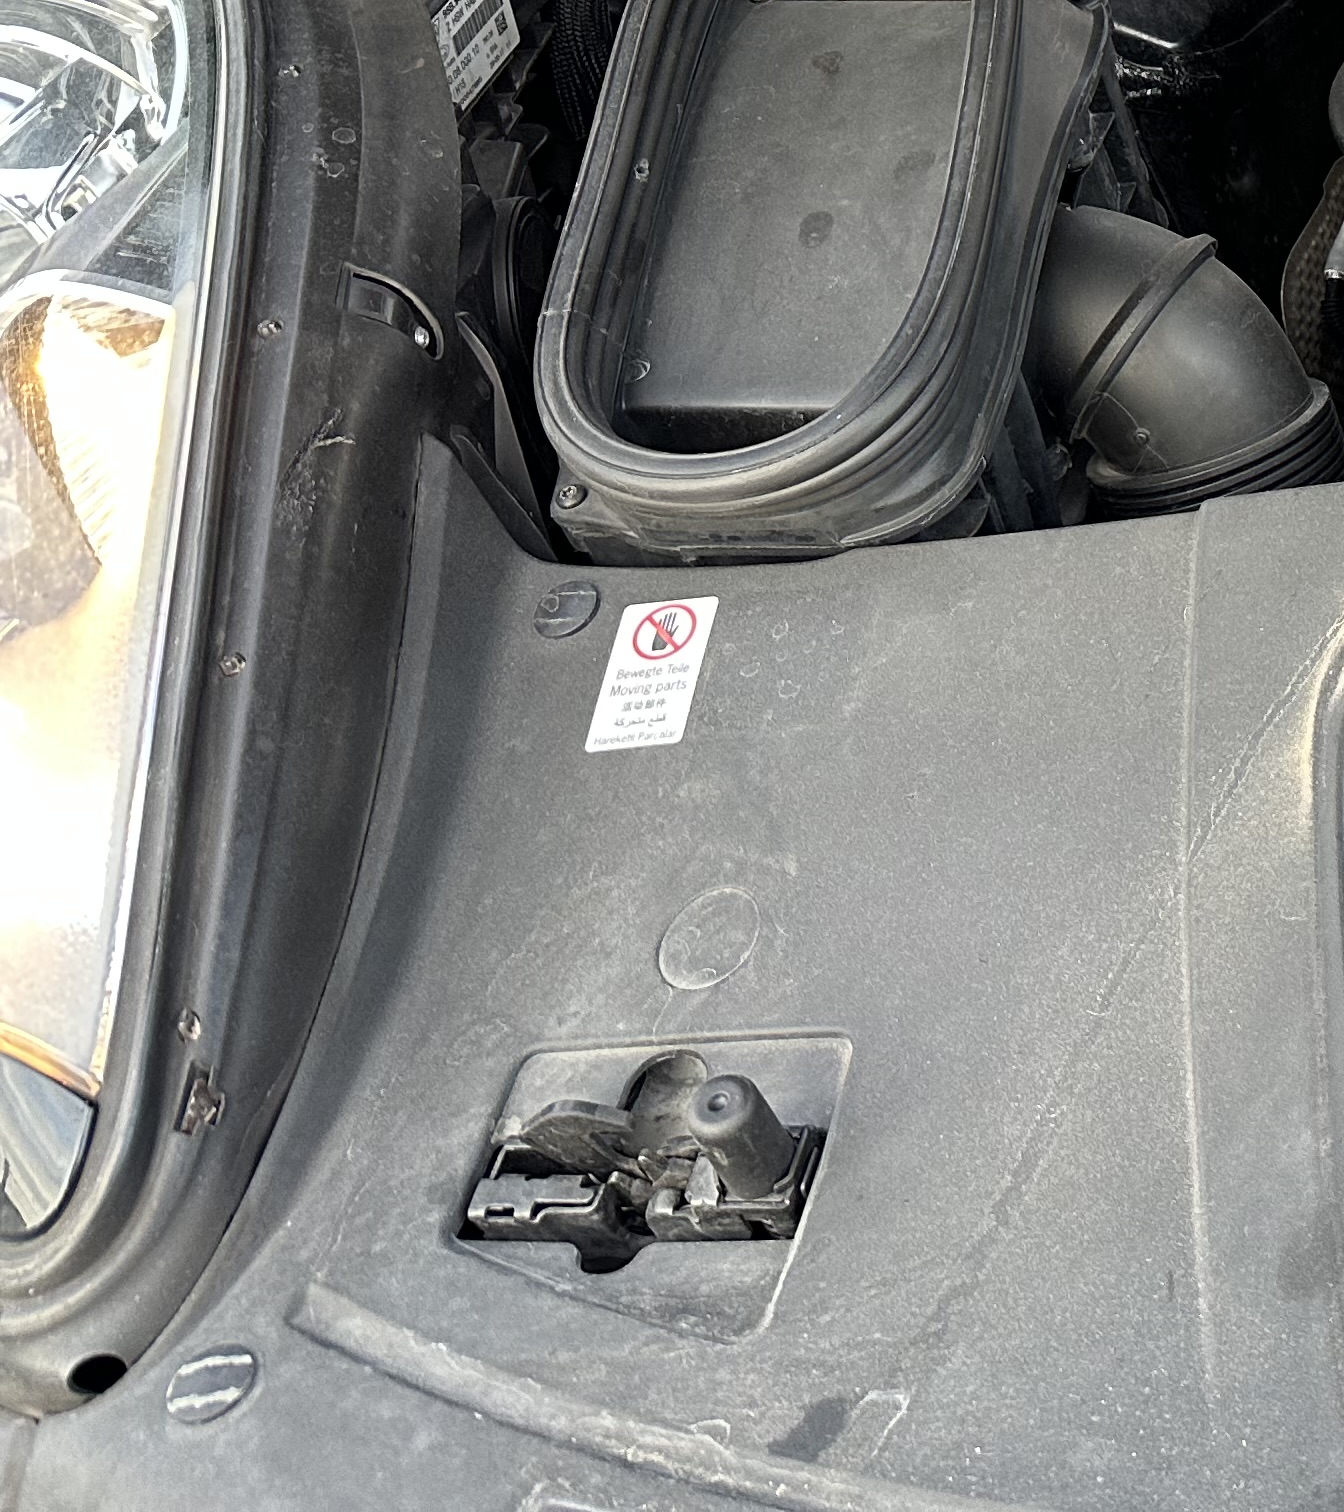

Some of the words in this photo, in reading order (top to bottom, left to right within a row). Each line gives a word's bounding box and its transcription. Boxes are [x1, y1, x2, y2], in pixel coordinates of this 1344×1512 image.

[616, 666, 663, 681] Bewegte
[667, 663, 690, 675] Teile
[609, 683, 652, 697] Moving
[655, 679, 688, 694] parts
